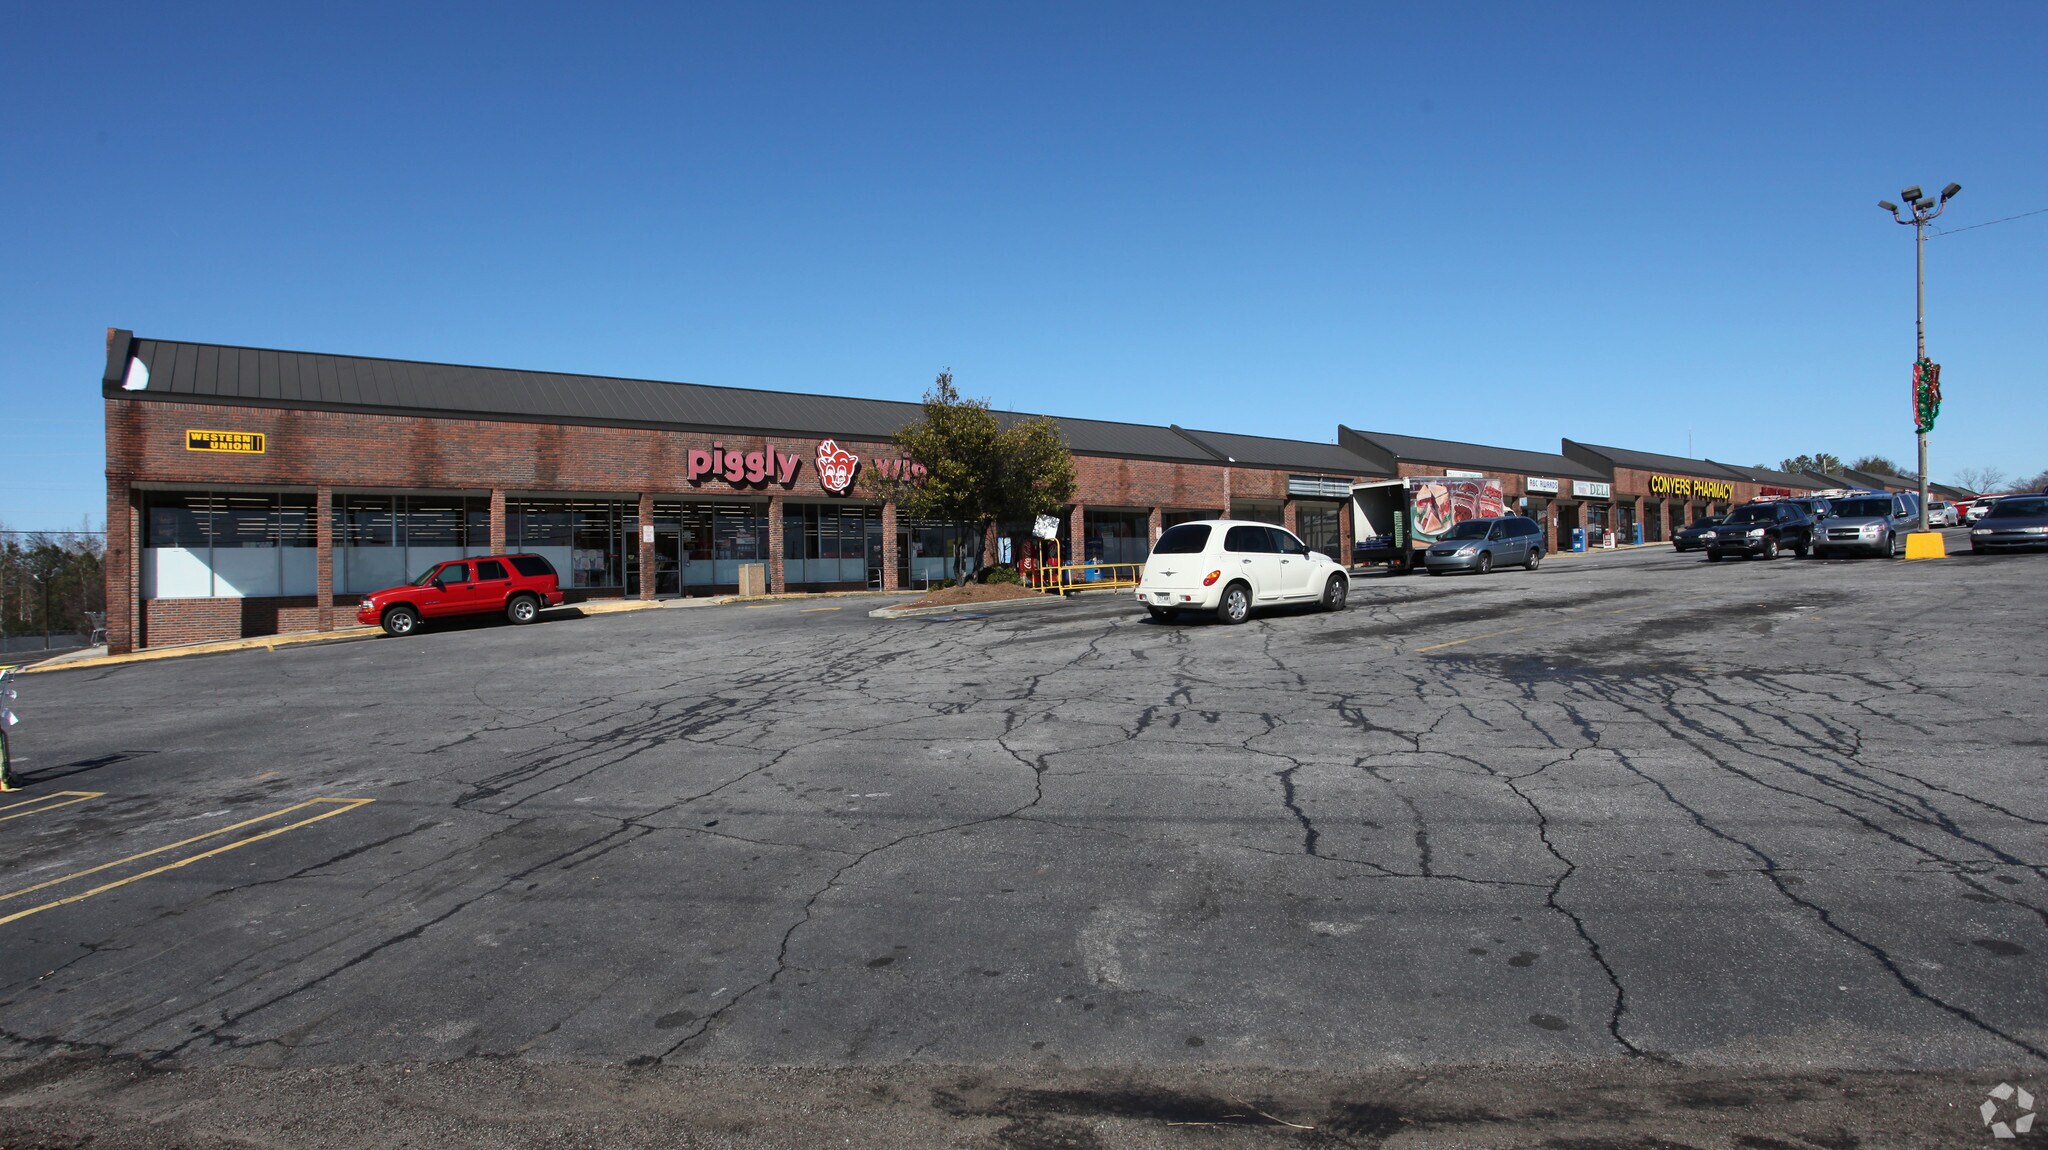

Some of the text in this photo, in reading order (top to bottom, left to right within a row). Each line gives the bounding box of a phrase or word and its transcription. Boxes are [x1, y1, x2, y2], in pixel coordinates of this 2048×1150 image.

[191, 432, 251, 442] WESTERN
[210, 441, 251, 449] UNION
[688, 442, 799, 483] piggly
[1589, 483, 1609, 496] DELI
[1651, 475, 1734, 499] CONYERS PHARMACY
